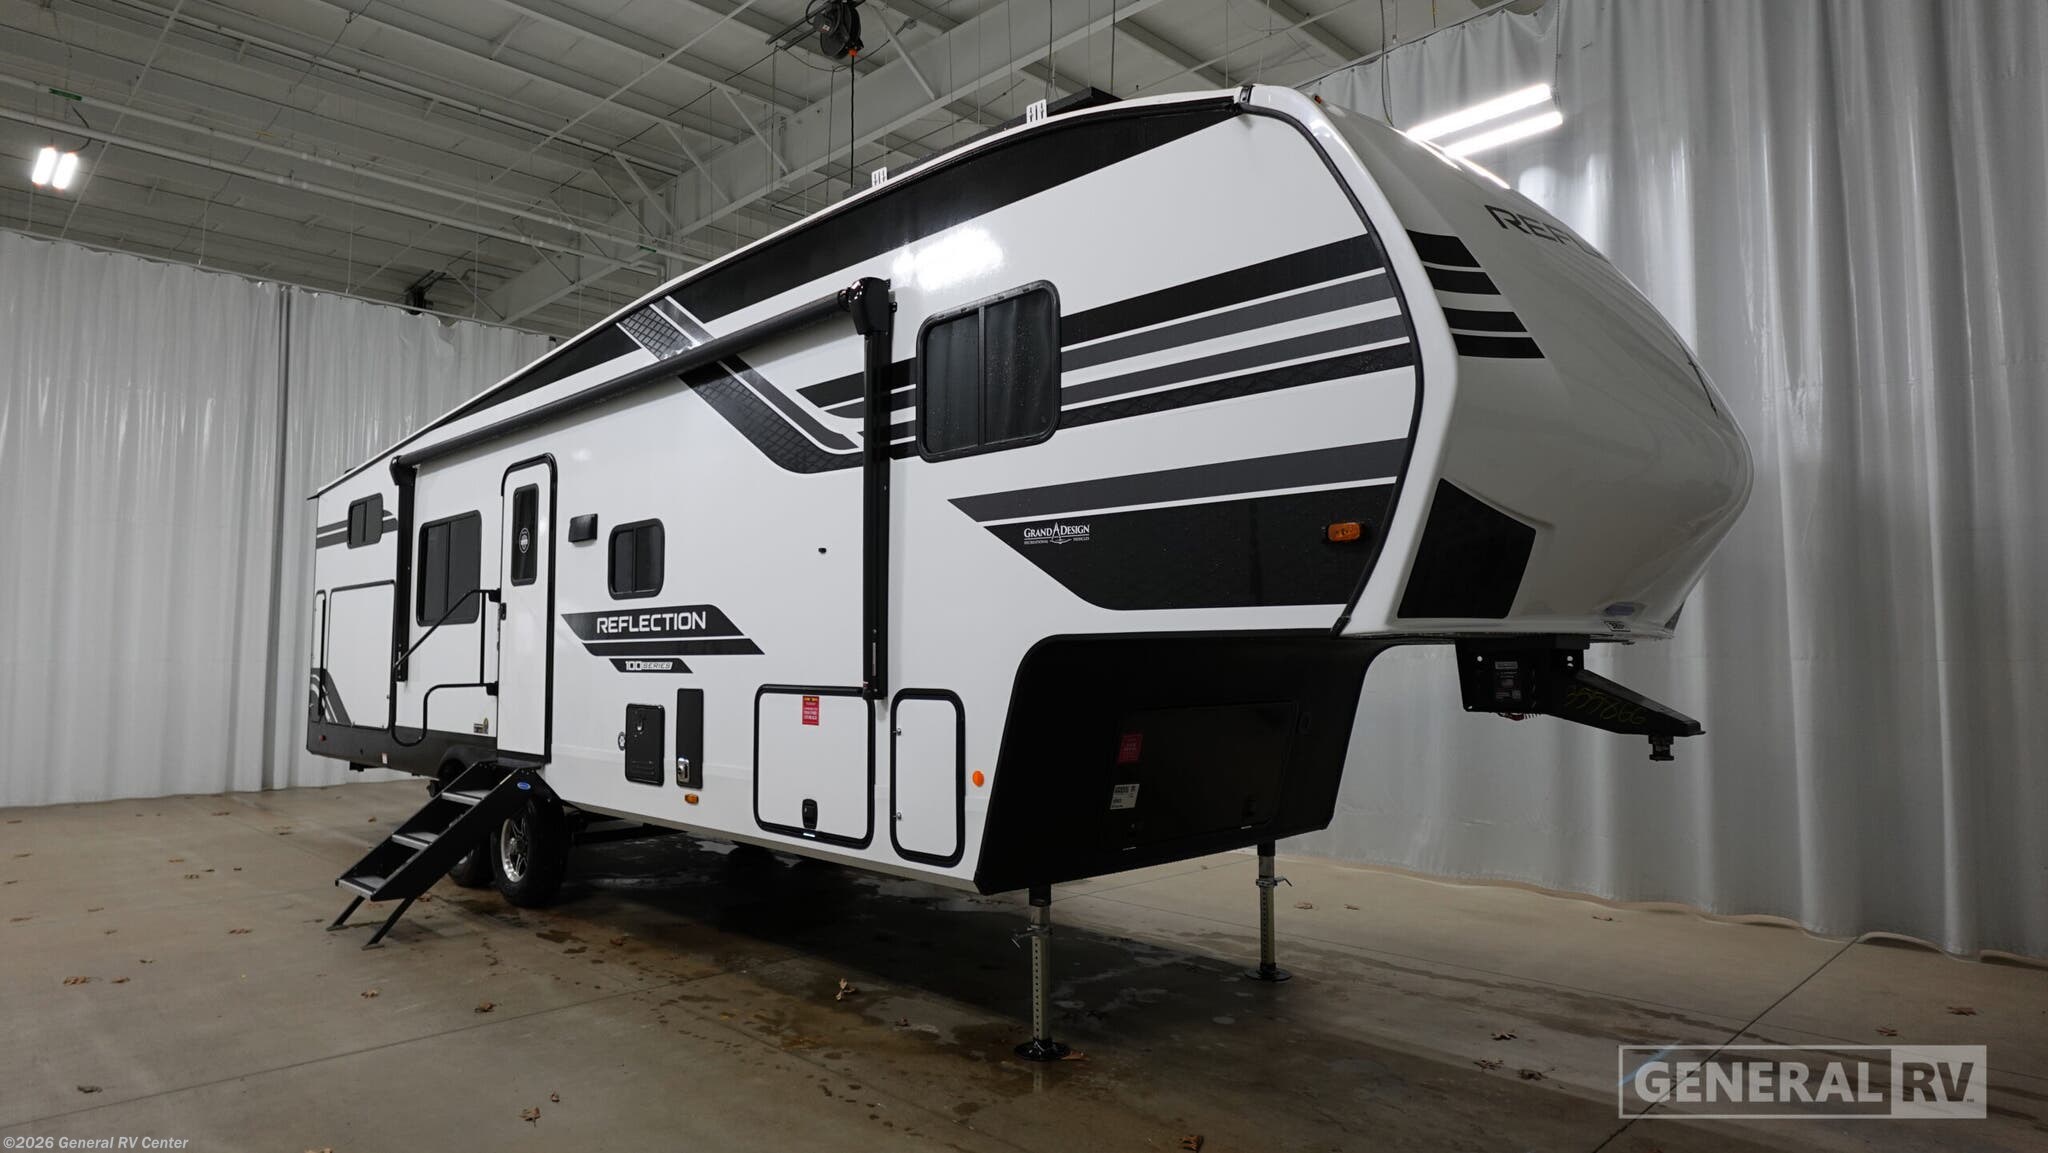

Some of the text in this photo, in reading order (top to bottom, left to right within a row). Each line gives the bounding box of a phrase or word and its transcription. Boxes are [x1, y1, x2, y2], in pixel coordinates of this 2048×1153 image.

[597, 611, 706, 633] REFLECTION
[625, 660, 673, 671] 100 SERIES
